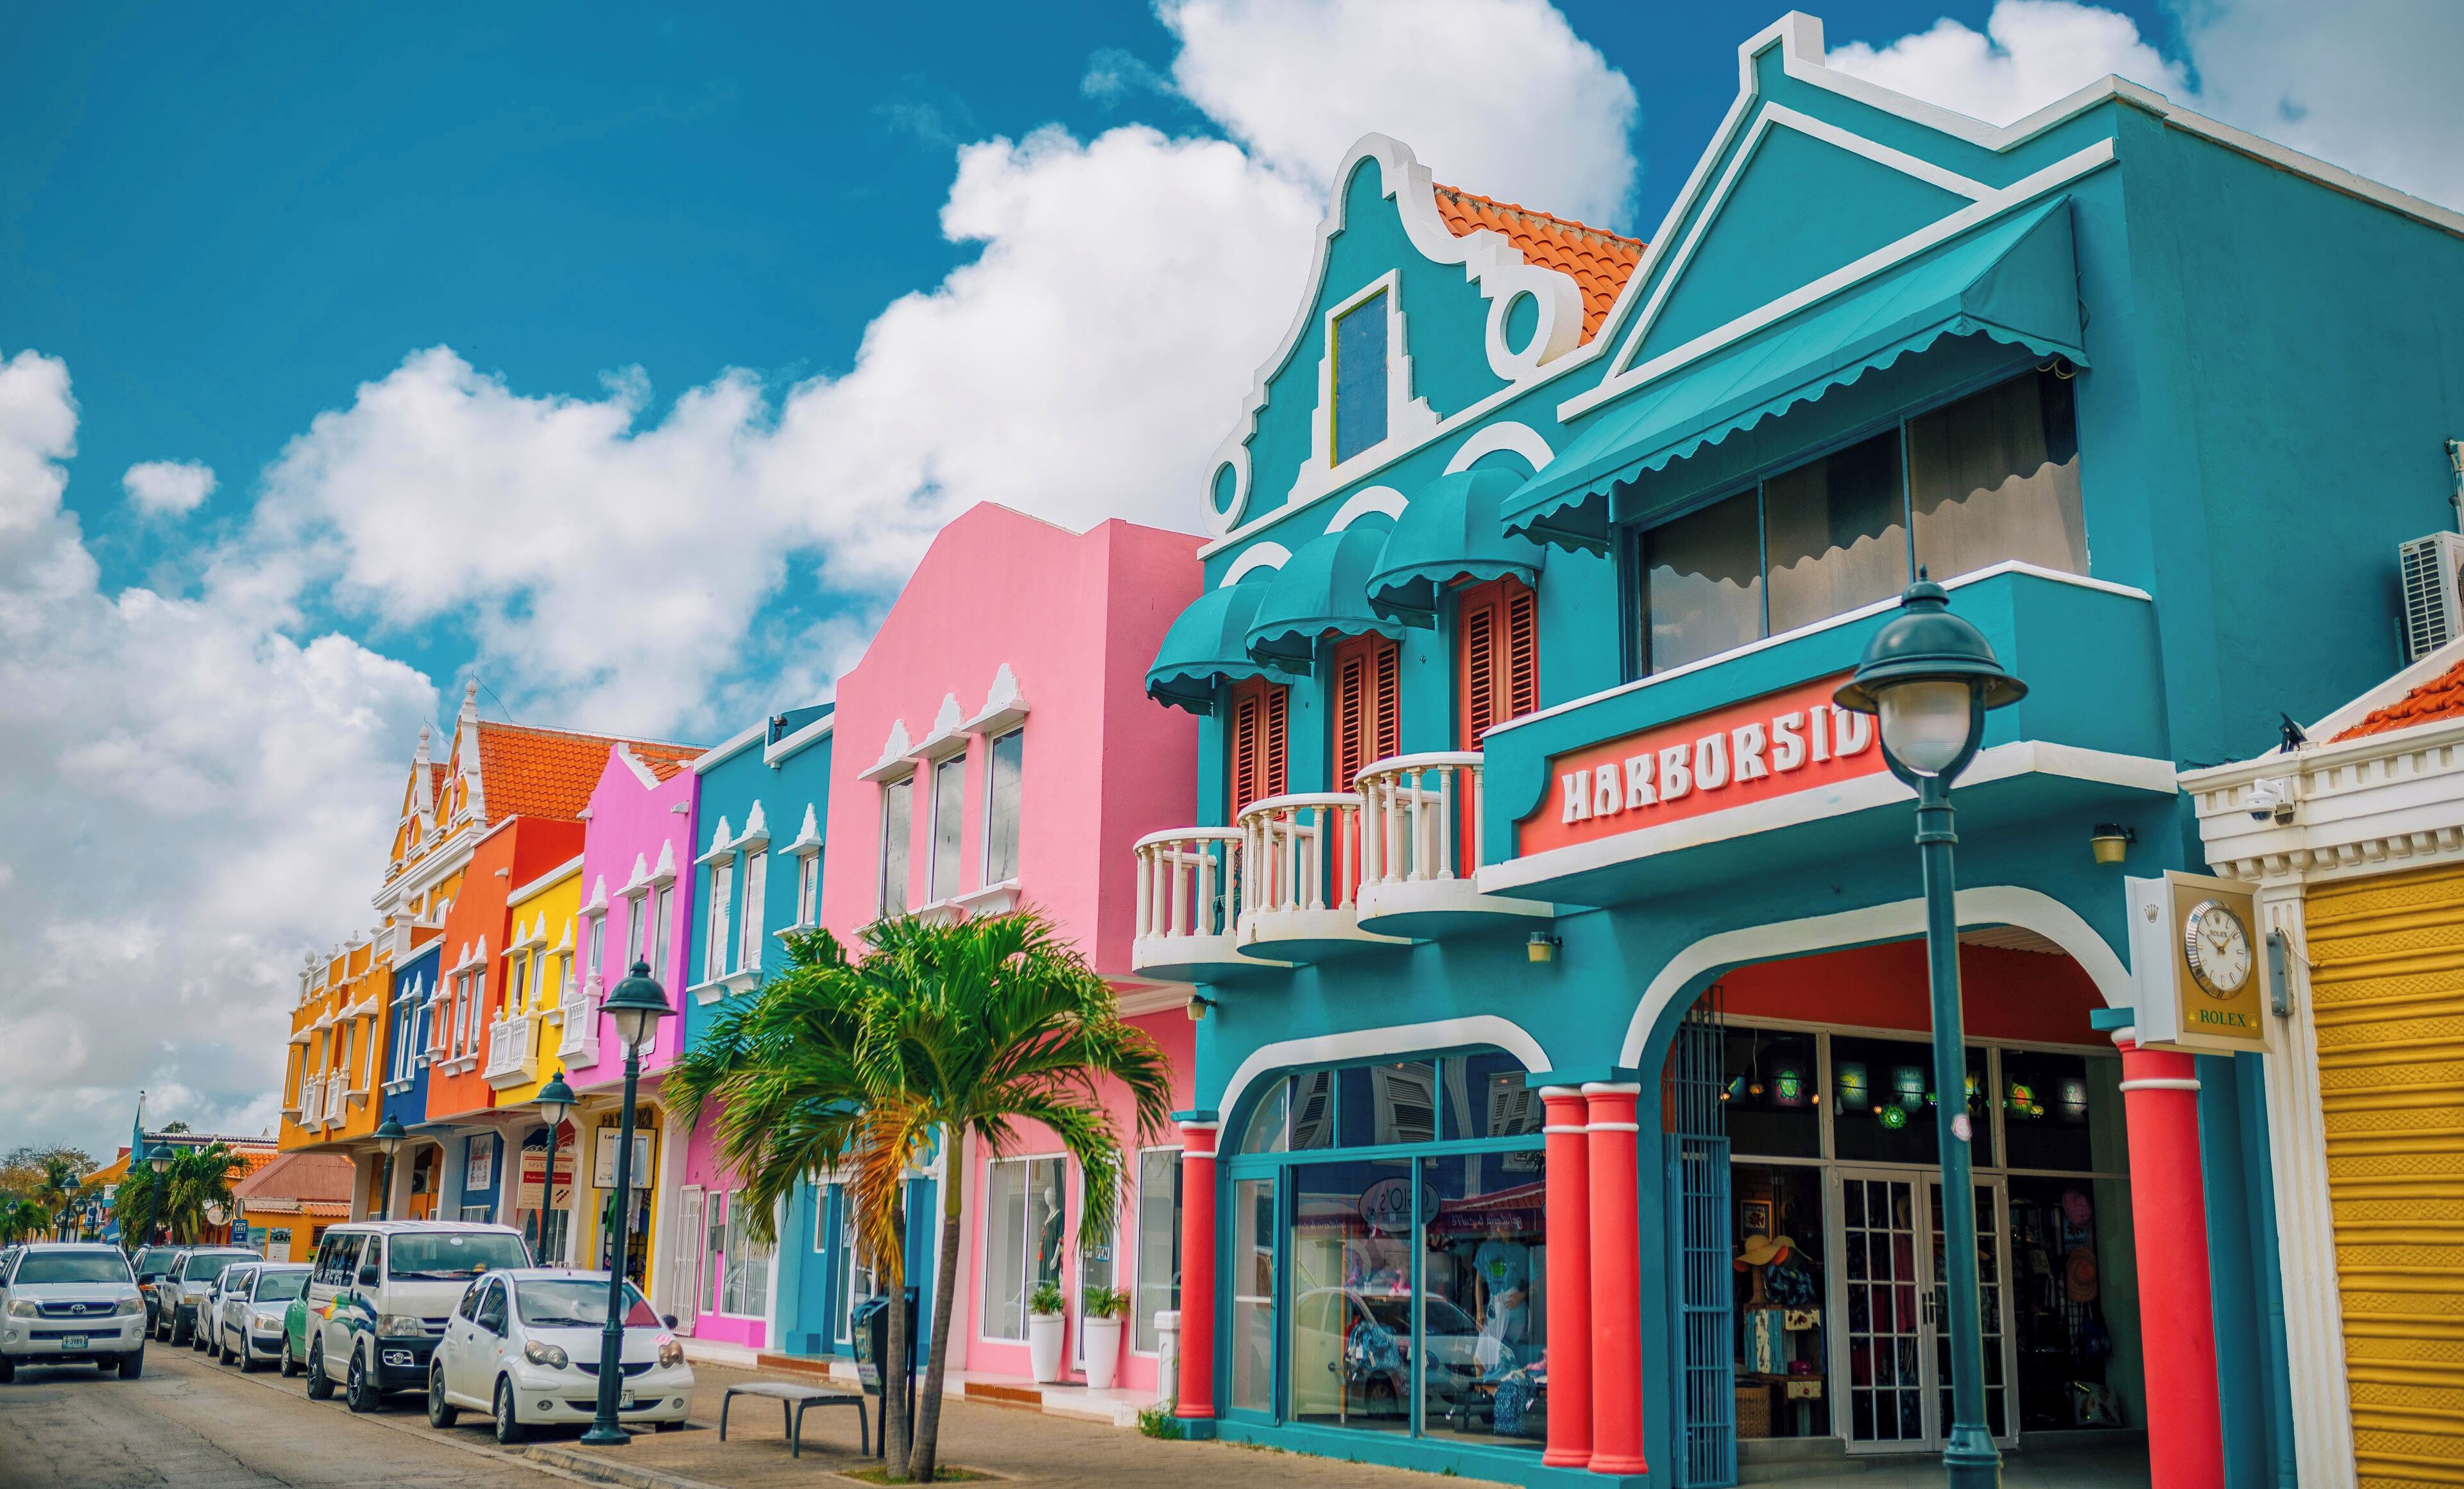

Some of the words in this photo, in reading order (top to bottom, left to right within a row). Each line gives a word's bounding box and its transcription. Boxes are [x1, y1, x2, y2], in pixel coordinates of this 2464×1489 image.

[1561, 703, 1881, 824] HARBORSID
[2200, 1009, 2246, 1027] ROLEX
[1097, 1246, 1109, 1259] PEN
